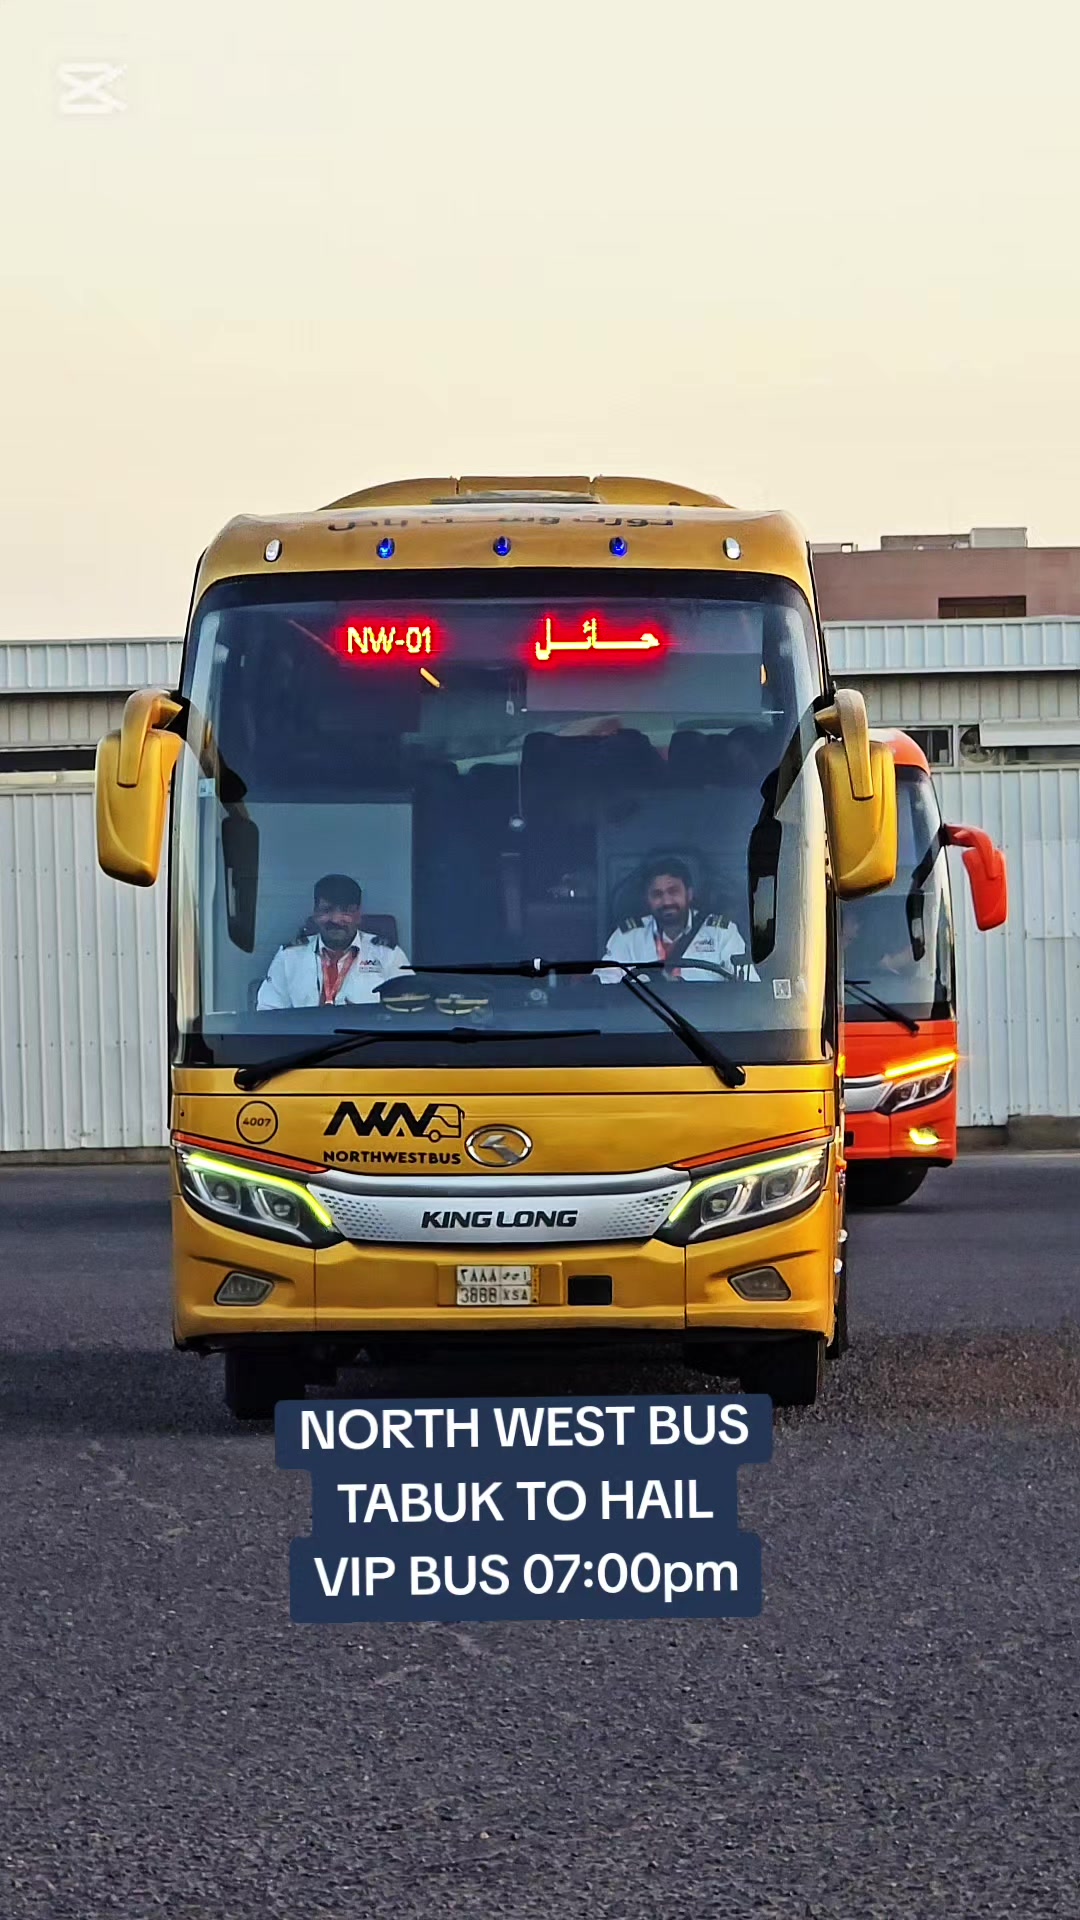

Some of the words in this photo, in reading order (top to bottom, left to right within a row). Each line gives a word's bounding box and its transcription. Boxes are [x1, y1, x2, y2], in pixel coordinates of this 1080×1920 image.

[347, 626, 432, 654] NW-01
[535, 617, 660, 661] حائل
[243, 1116, 271, 1128] 4007
[323, 1150, 462, 1165] NORTHWESTBUS
[421, 1211, 493, 1229] KING
[496, 1210, 578, 1228] LONG
[460, 1286, 497, 1303] 3888
